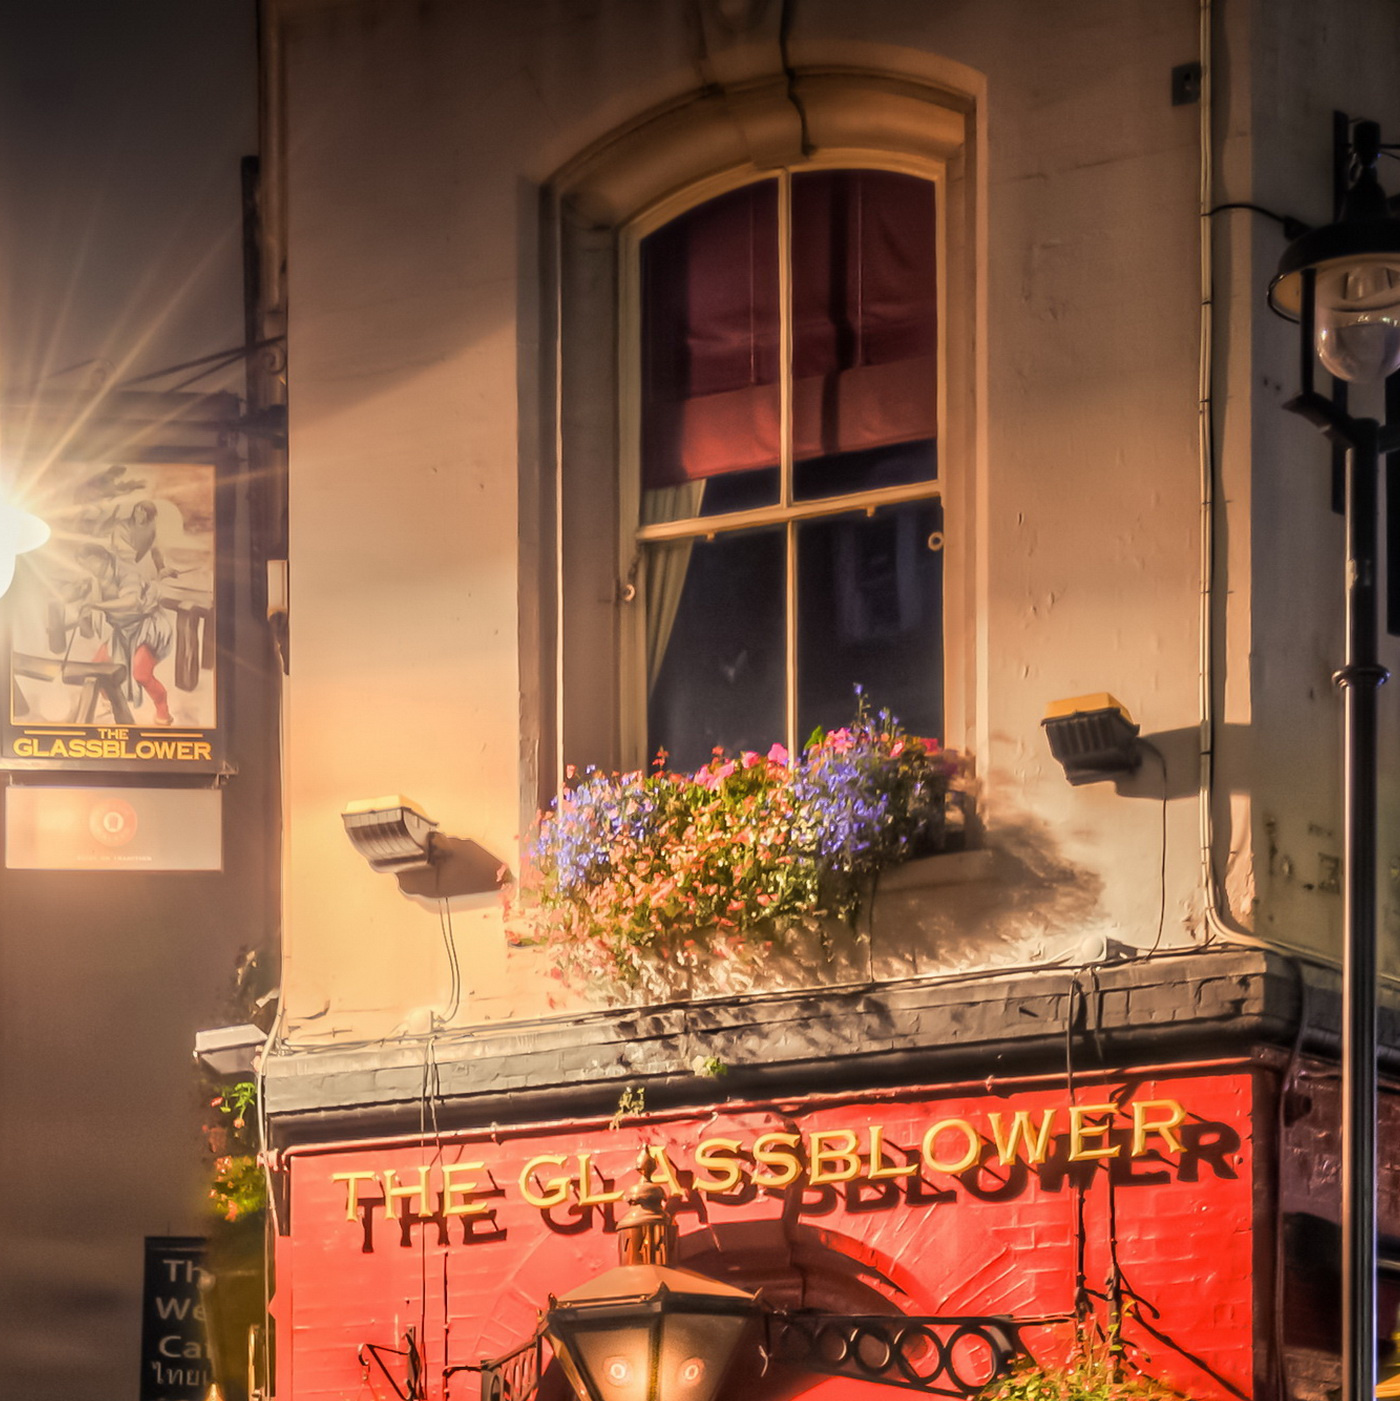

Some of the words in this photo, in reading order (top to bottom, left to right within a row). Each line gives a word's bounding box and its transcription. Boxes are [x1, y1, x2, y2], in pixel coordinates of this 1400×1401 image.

[97, 728, 130, 740] THE
[13, 738, 213, 760] GLASSBLOWER
[332, 1159, 493, 1222] THE
[518, 1097, 1188, 1210] GLASSBLOWER
[162, 1258, 205, 1284] Th
